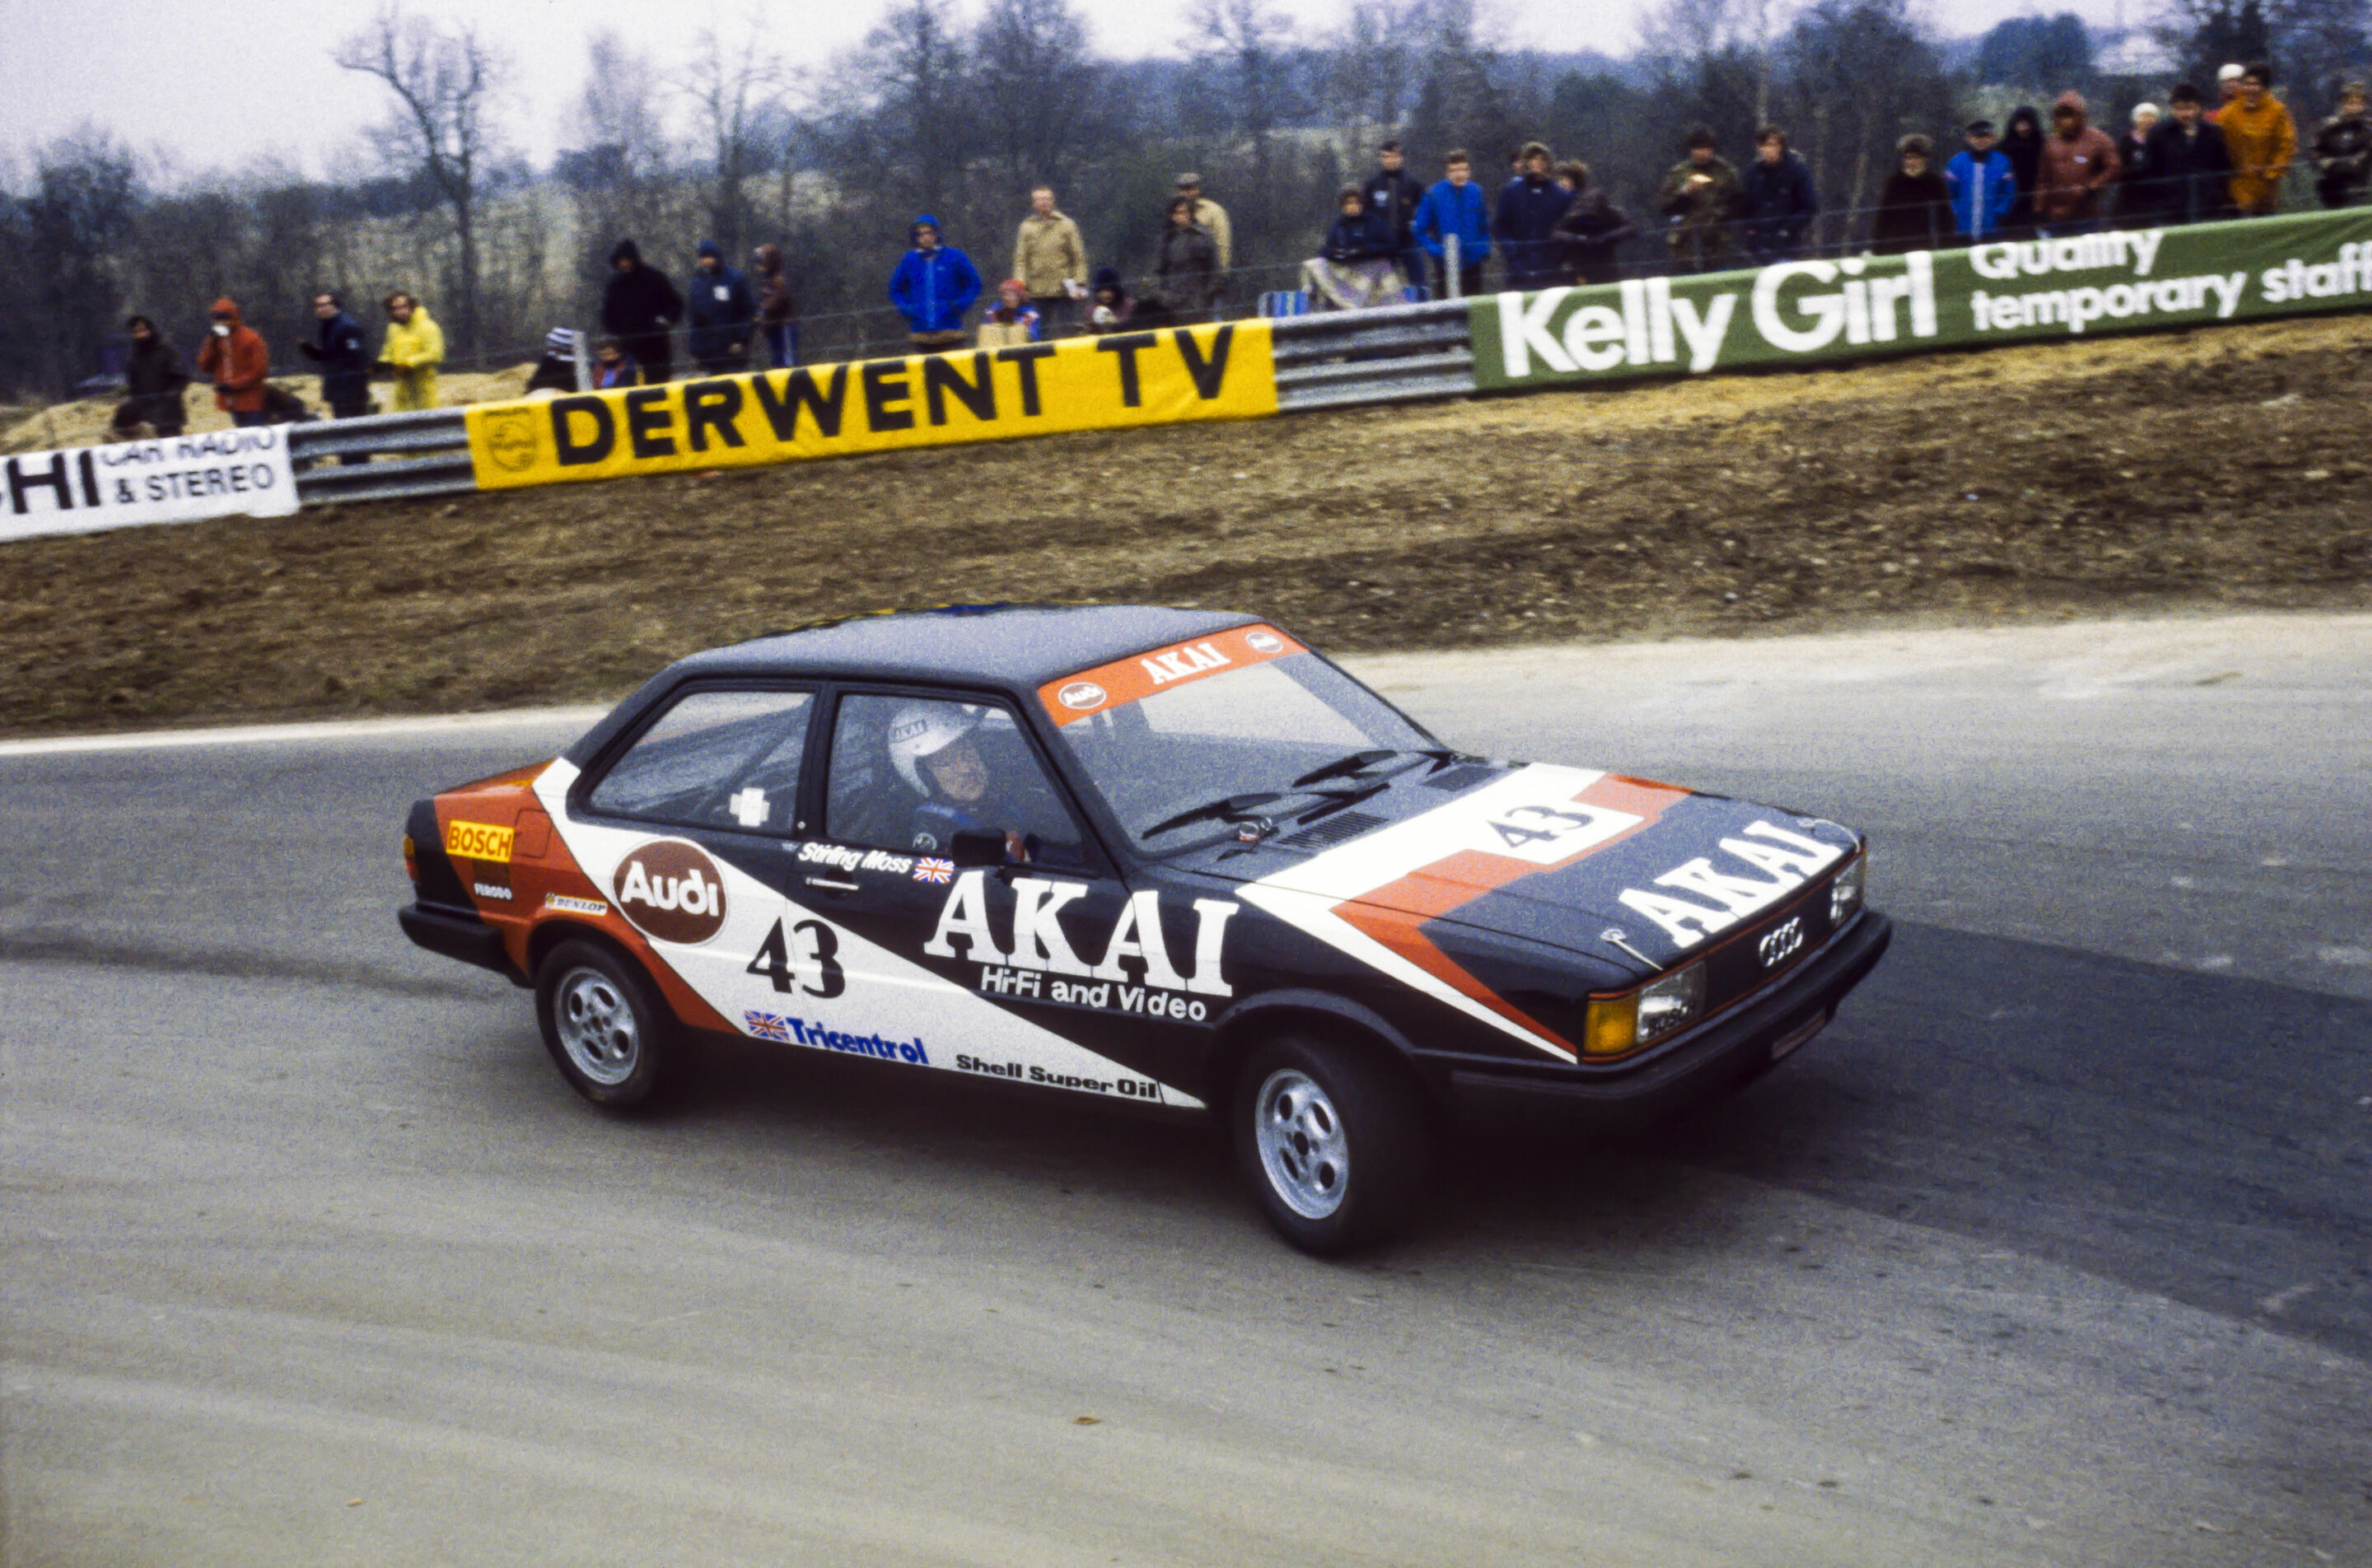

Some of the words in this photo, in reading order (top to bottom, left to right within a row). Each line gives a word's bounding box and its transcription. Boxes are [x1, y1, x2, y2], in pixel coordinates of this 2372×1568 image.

[1497, 277, 1738, 376] Kelly
[1752, 250, 1937, 352] Girl
[1970, 272, 2247, 333] temporary
[552, 345, 1055, 465] DERWENT
[1097, 325, 1234, 408] TV
[0, 450, 100, 515] HI
[117, 478, 137, 504] &
[146, 464, 274, 502] STEREO
[1141, 642, 1231, 684] AKAI
[449, 825, 511, 856] BOSCH
[1486, 805, 1595, 849] 43
[798, 842, 865, 871] Stirling
[861, 850, 913, 873] Moss
[557, 898, 606, 912] DUNLOP
[620, 861, 719, 916] Audi
[1618, 820, 1844, 948] AKAI
[923, 870, 1240, 996] AKAI
[746, 916, 845, 999] 43
[1051, 981, 1109, 1008] and
[1118, 984, 1206, 1021] Video
[786, 1017, 929, 1065] Tricentrol
[956, 1054, 1022, 1079] Shell
[1030, 1066, 1114, 1093] Super
[1118, 1079, 1157, 1099] Oil
